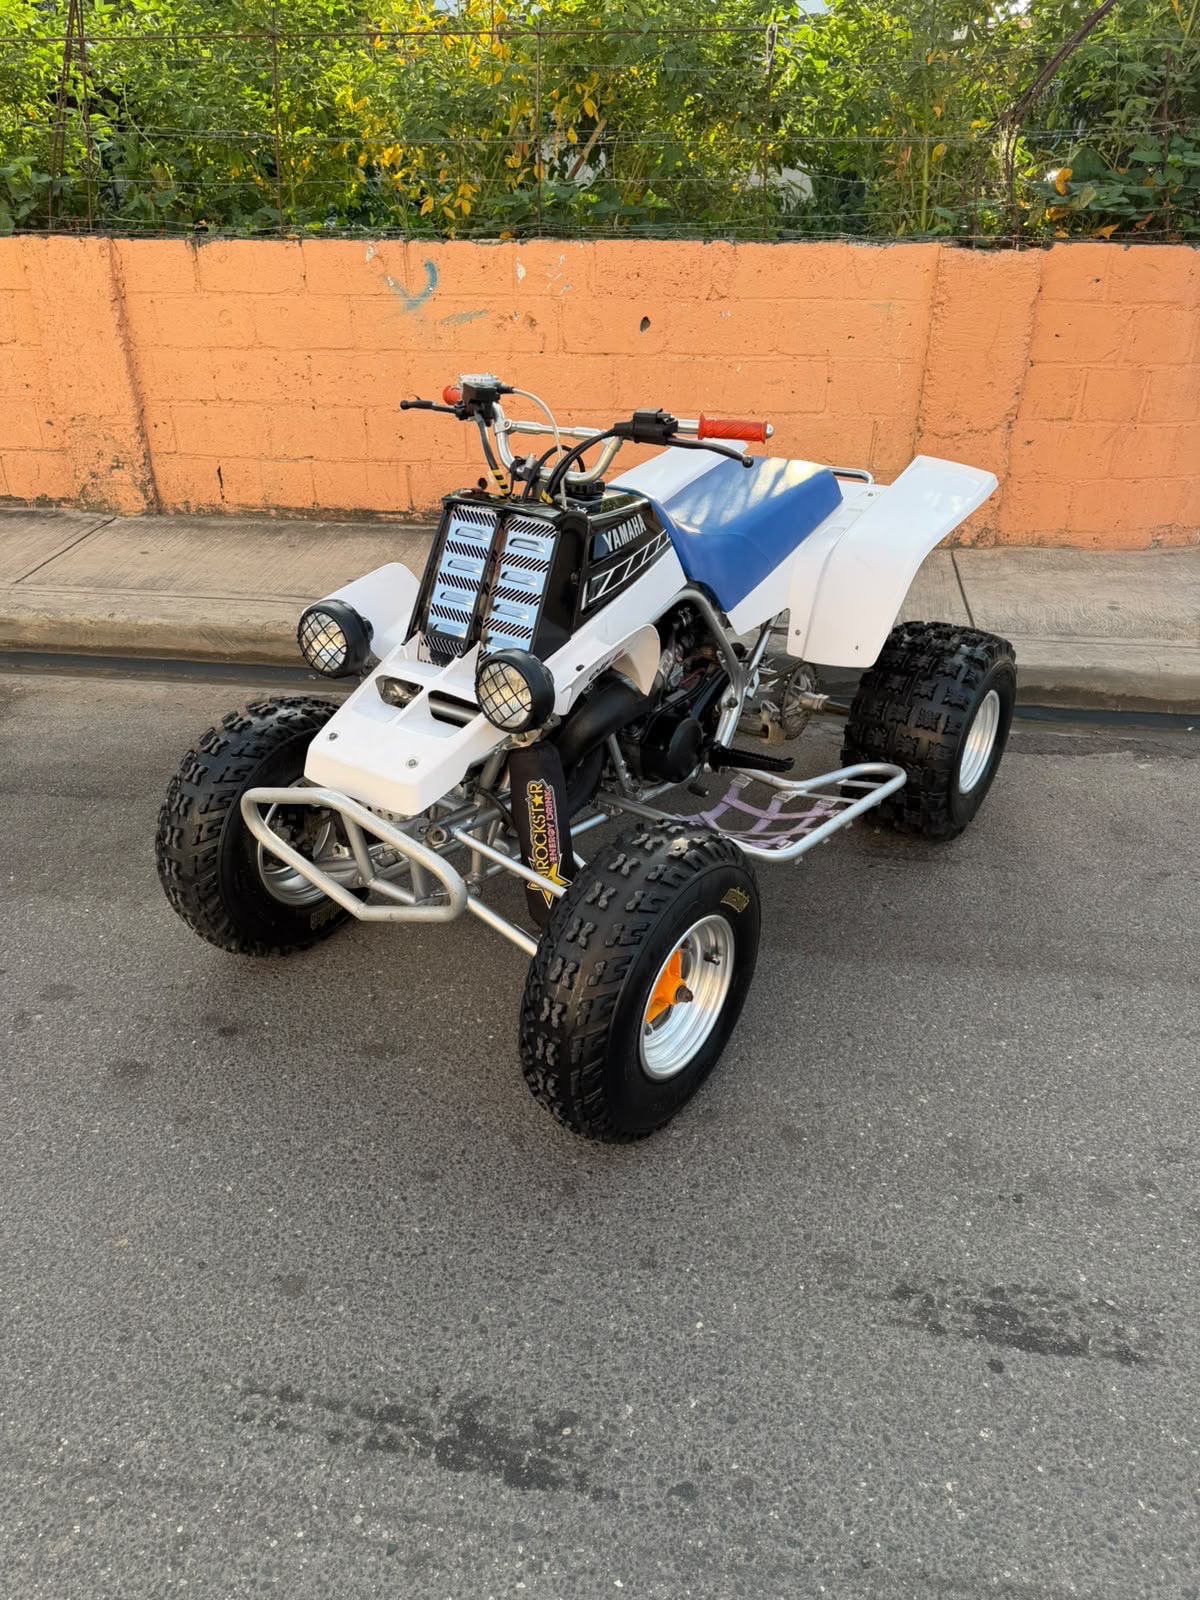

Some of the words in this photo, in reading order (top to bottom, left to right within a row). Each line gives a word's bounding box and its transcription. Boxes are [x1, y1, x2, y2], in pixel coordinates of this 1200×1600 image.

[601, 514, 647, 552] YAMAHA
[543, 788, 554, 821] DRINK
[546, 823, 558, 864] ENERGY
